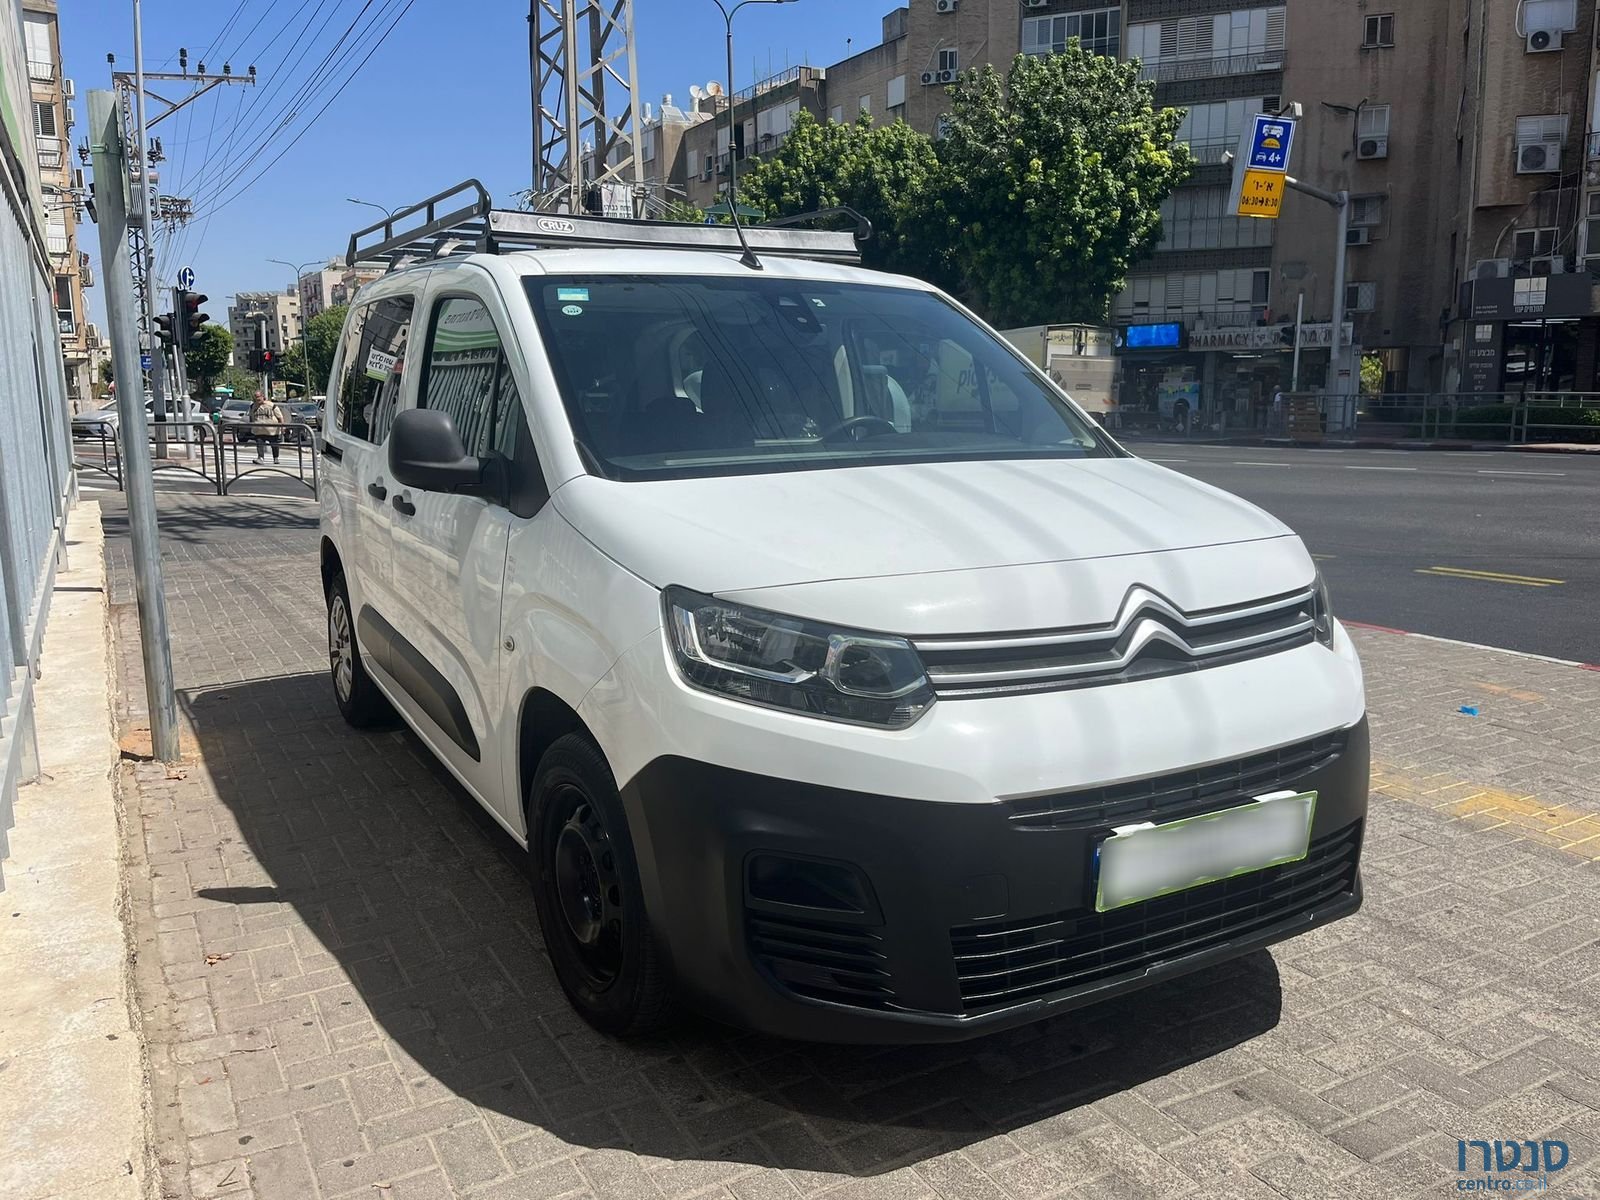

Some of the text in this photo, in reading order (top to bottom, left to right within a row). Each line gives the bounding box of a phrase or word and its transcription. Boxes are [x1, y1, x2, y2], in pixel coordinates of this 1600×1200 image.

[1268, 152, 1281, 163] 4+
[540, 220, 571, 231] CRUZ
[1188, 332, 1249, 348] PHARMACY
